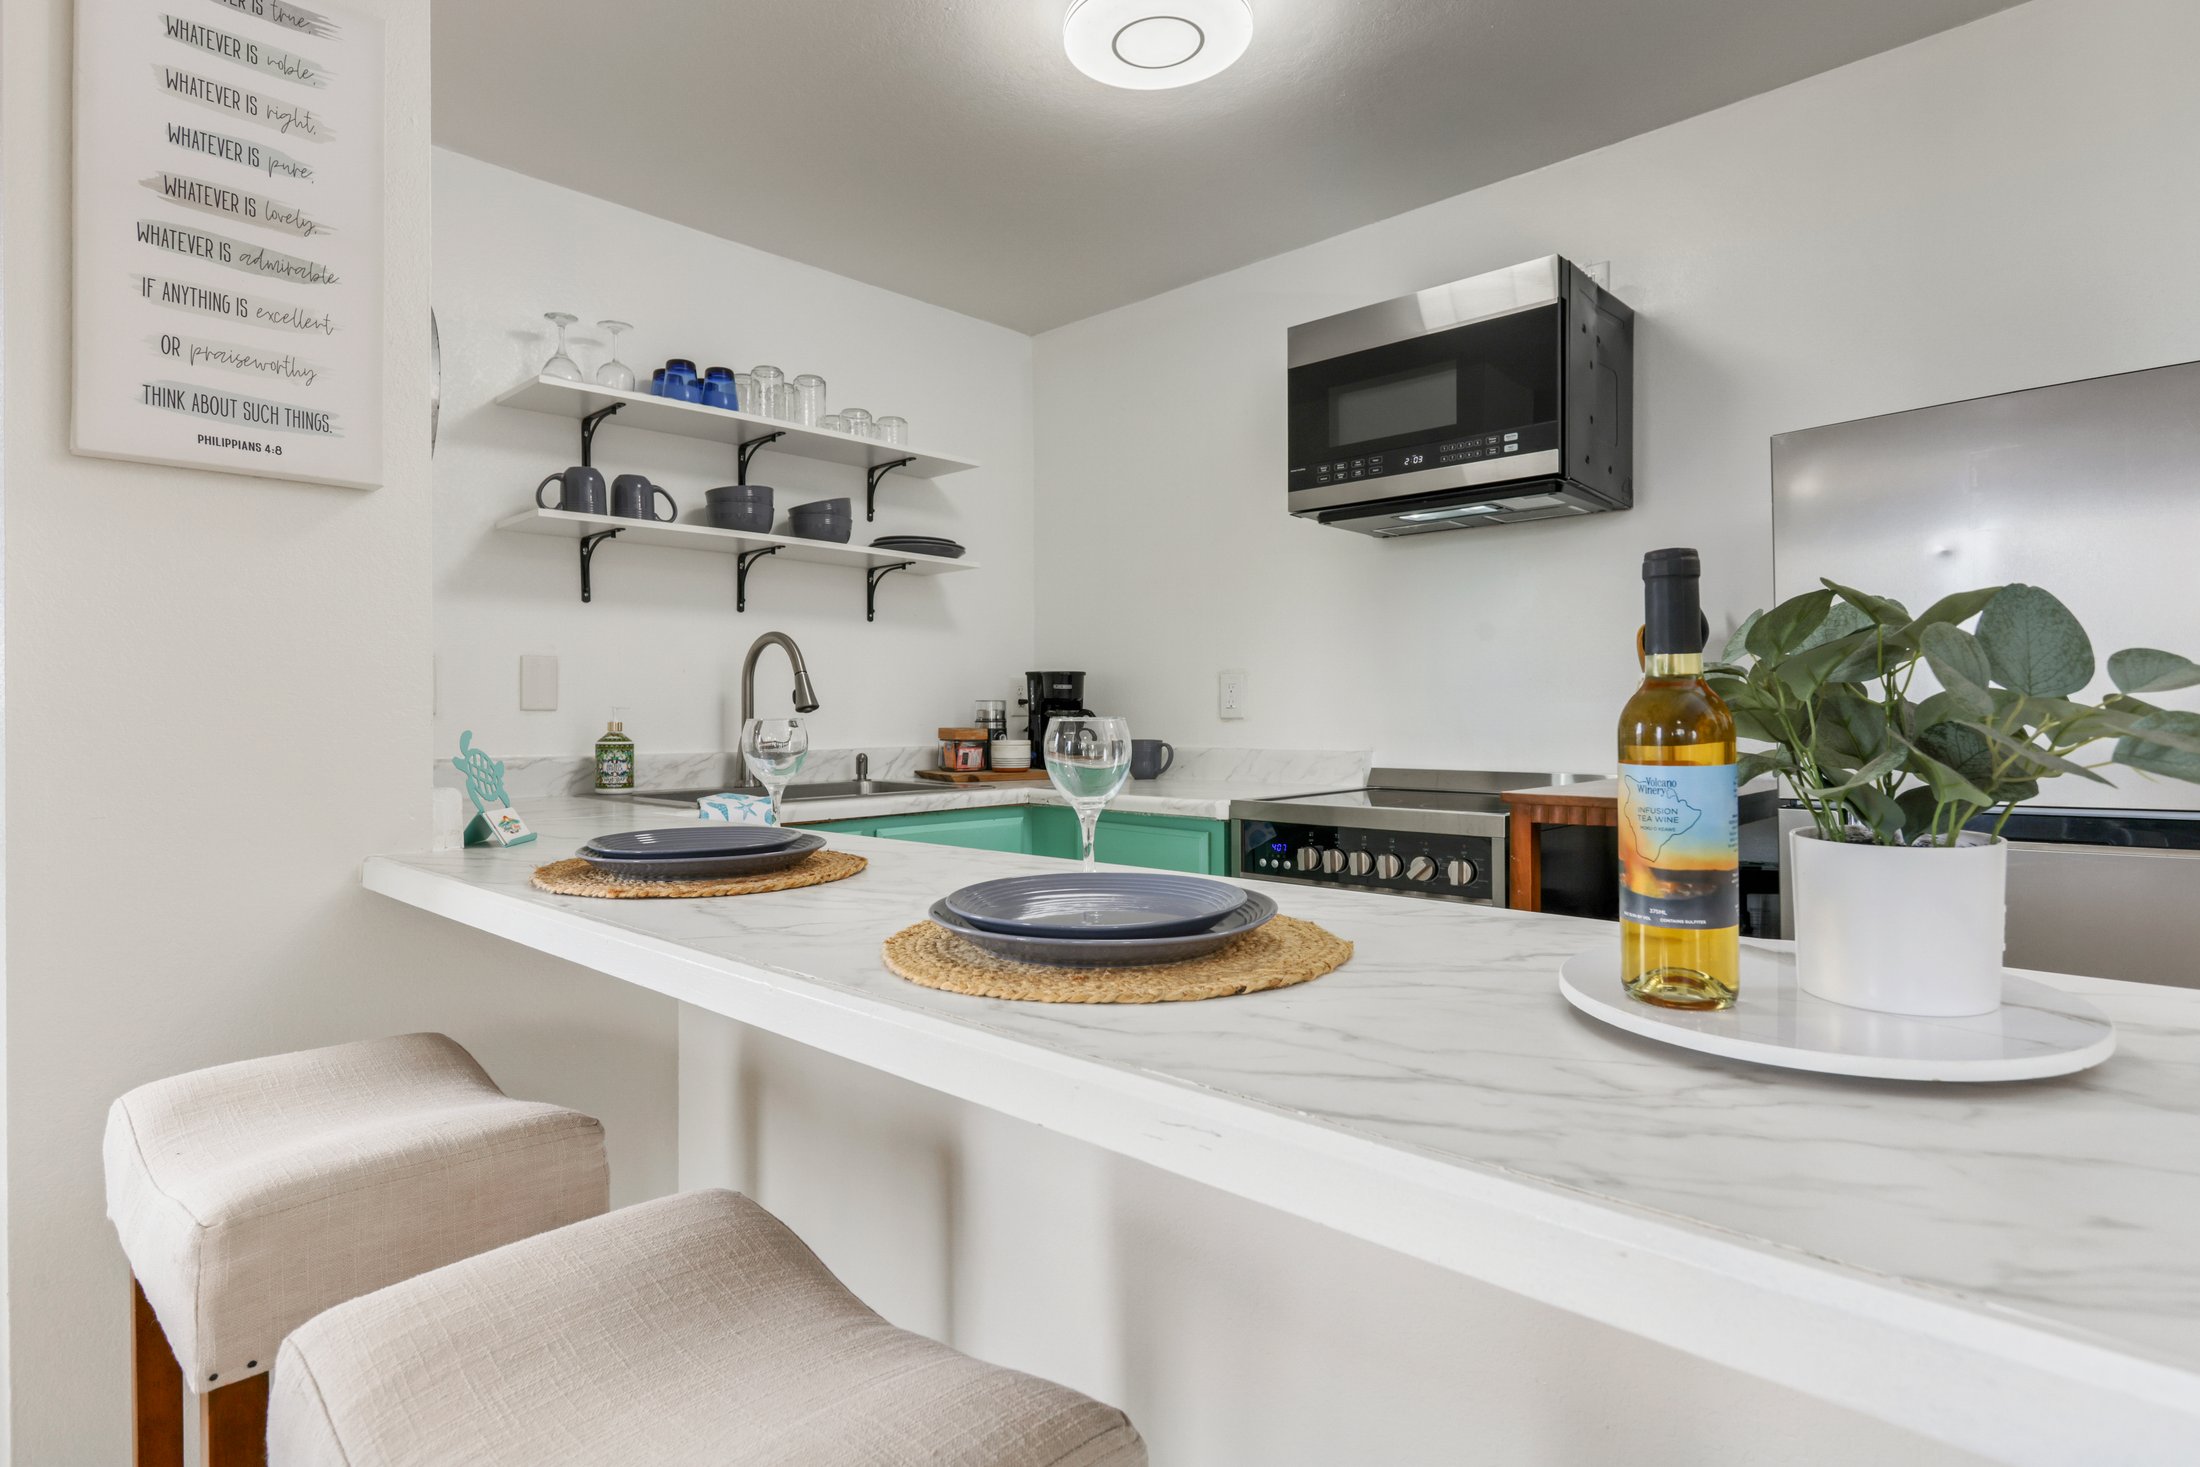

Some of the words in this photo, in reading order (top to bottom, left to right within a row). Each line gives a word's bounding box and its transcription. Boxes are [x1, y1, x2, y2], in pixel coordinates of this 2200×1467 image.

[270, 0, 312, 34] true.
[166, 15, 241, 59] WHATEVER
[246, 43, 258, 64] IS
[267, 54, 316, 86] noble.
[166, 68, 240, 110] WHATEVER
[246, 94, 258, 116] IS
[267, 104, 316, 135] right.
[168, 122, 242, 163] WHATEVER
[248, 146, 260, 168] IS
[268, 156, 315, 184] pure.
[164, 174, 238, 214] WHATEVER
[245, 198, 256, 218] IS
[265, 200, 318, 237] lovely.
[136, 222, 214, 259] WHATEVER
[219, 242, 231, 263] IS
[239, 248, 340, 286] admirable
[142, 276, 156, 298] IF
[162, 281, 231, 314] ANYTHING
[236, 297, 248, 318] IS
[256, 307, 334, 336] excellent
[161, 334, 181, 357] OR
[190, 343, 318, 387] praiseworthy
[142, 384, 186, 411] THINK
[192, 392, 238, 419] ABOUT
[243, 401, 280, 426] SUCH
[285, 407, 333, 434] THINGS.
[197, 434, 262, 453] PHILIPPIANS
[264, 444, 283, 456] 4:8
[1637, 784, 1665, 797] Winery
[1646, 777, 1677, 788] Volcano
[1637, 807, 1678, 815] INFUSION
[1655, 816, 1679, 824] WINE
